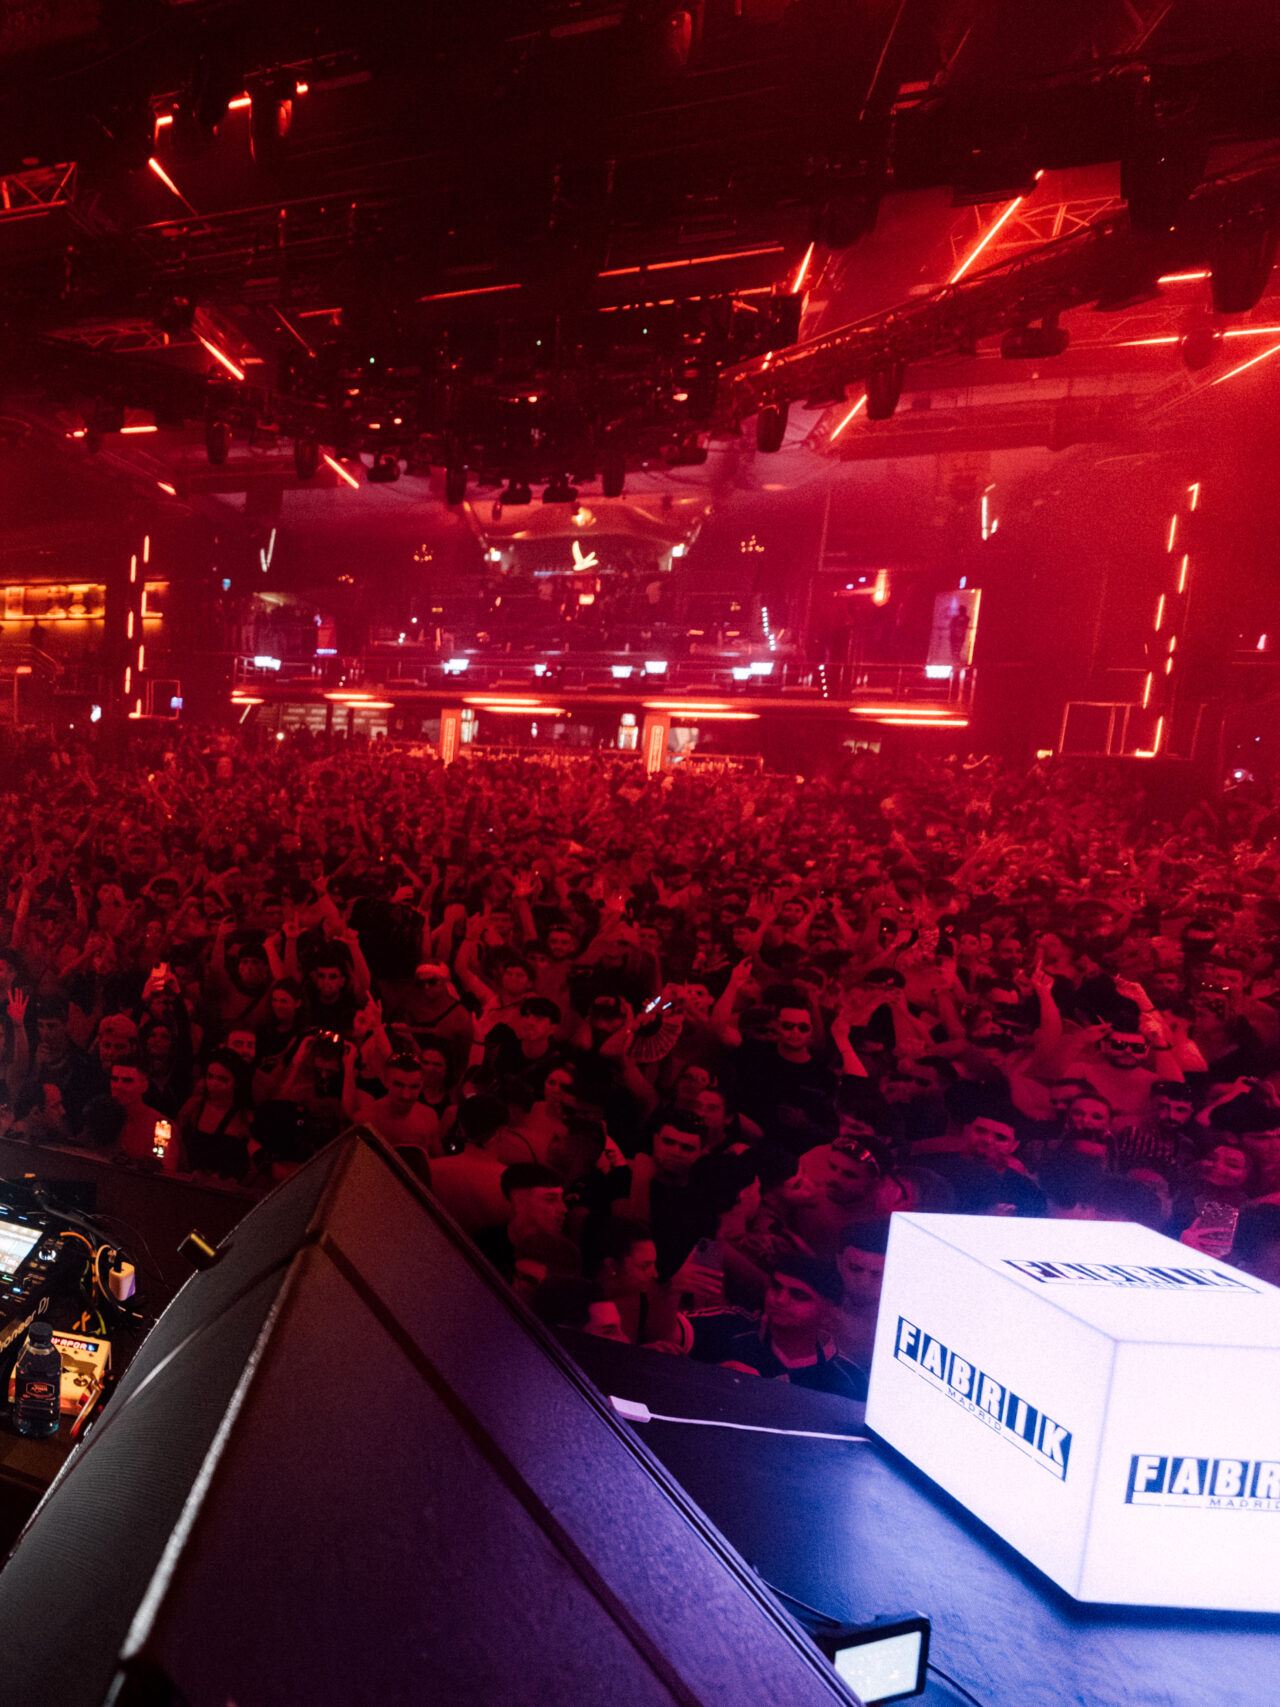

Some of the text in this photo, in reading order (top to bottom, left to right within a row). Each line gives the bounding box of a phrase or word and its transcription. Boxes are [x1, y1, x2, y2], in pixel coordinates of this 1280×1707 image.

[1007, 1259, 1247, 1288] FABRIK
[897, 1317, 1070, 1467] FABRIK
[947, 1387, 1002, 1431] MADRID
